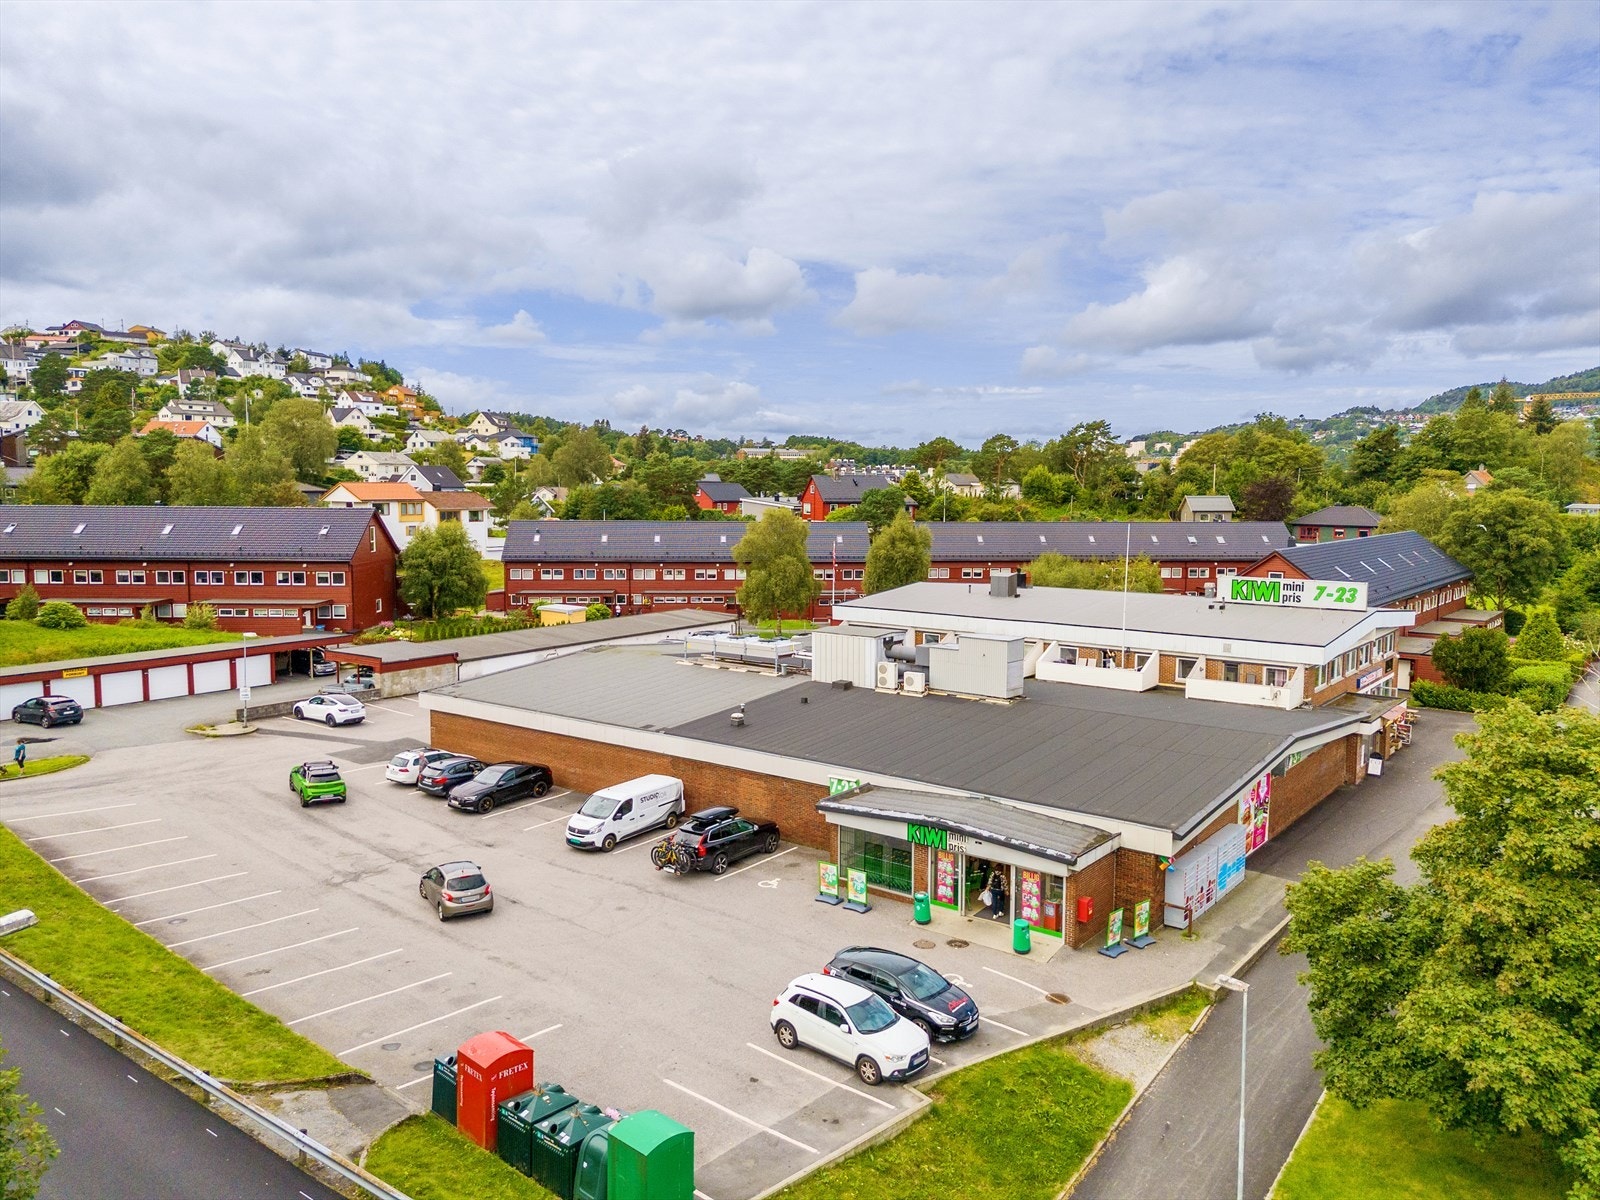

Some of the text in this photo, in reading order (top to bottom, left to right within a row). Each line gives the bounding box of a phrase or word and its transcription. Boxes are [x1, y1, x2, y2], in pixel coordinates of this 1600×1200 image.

[1231, 579, 1281, 602] KIWI
[1282, 581, 1305, 592] mini
[1313, 585, 1358, 603] 7-23
[1282, 593, 1302, 604] pris
[907, 822, 948, 850] KIWI
[948, 842, 965, 853] pris
[498, 1061, 529, 1080] FRETEX
